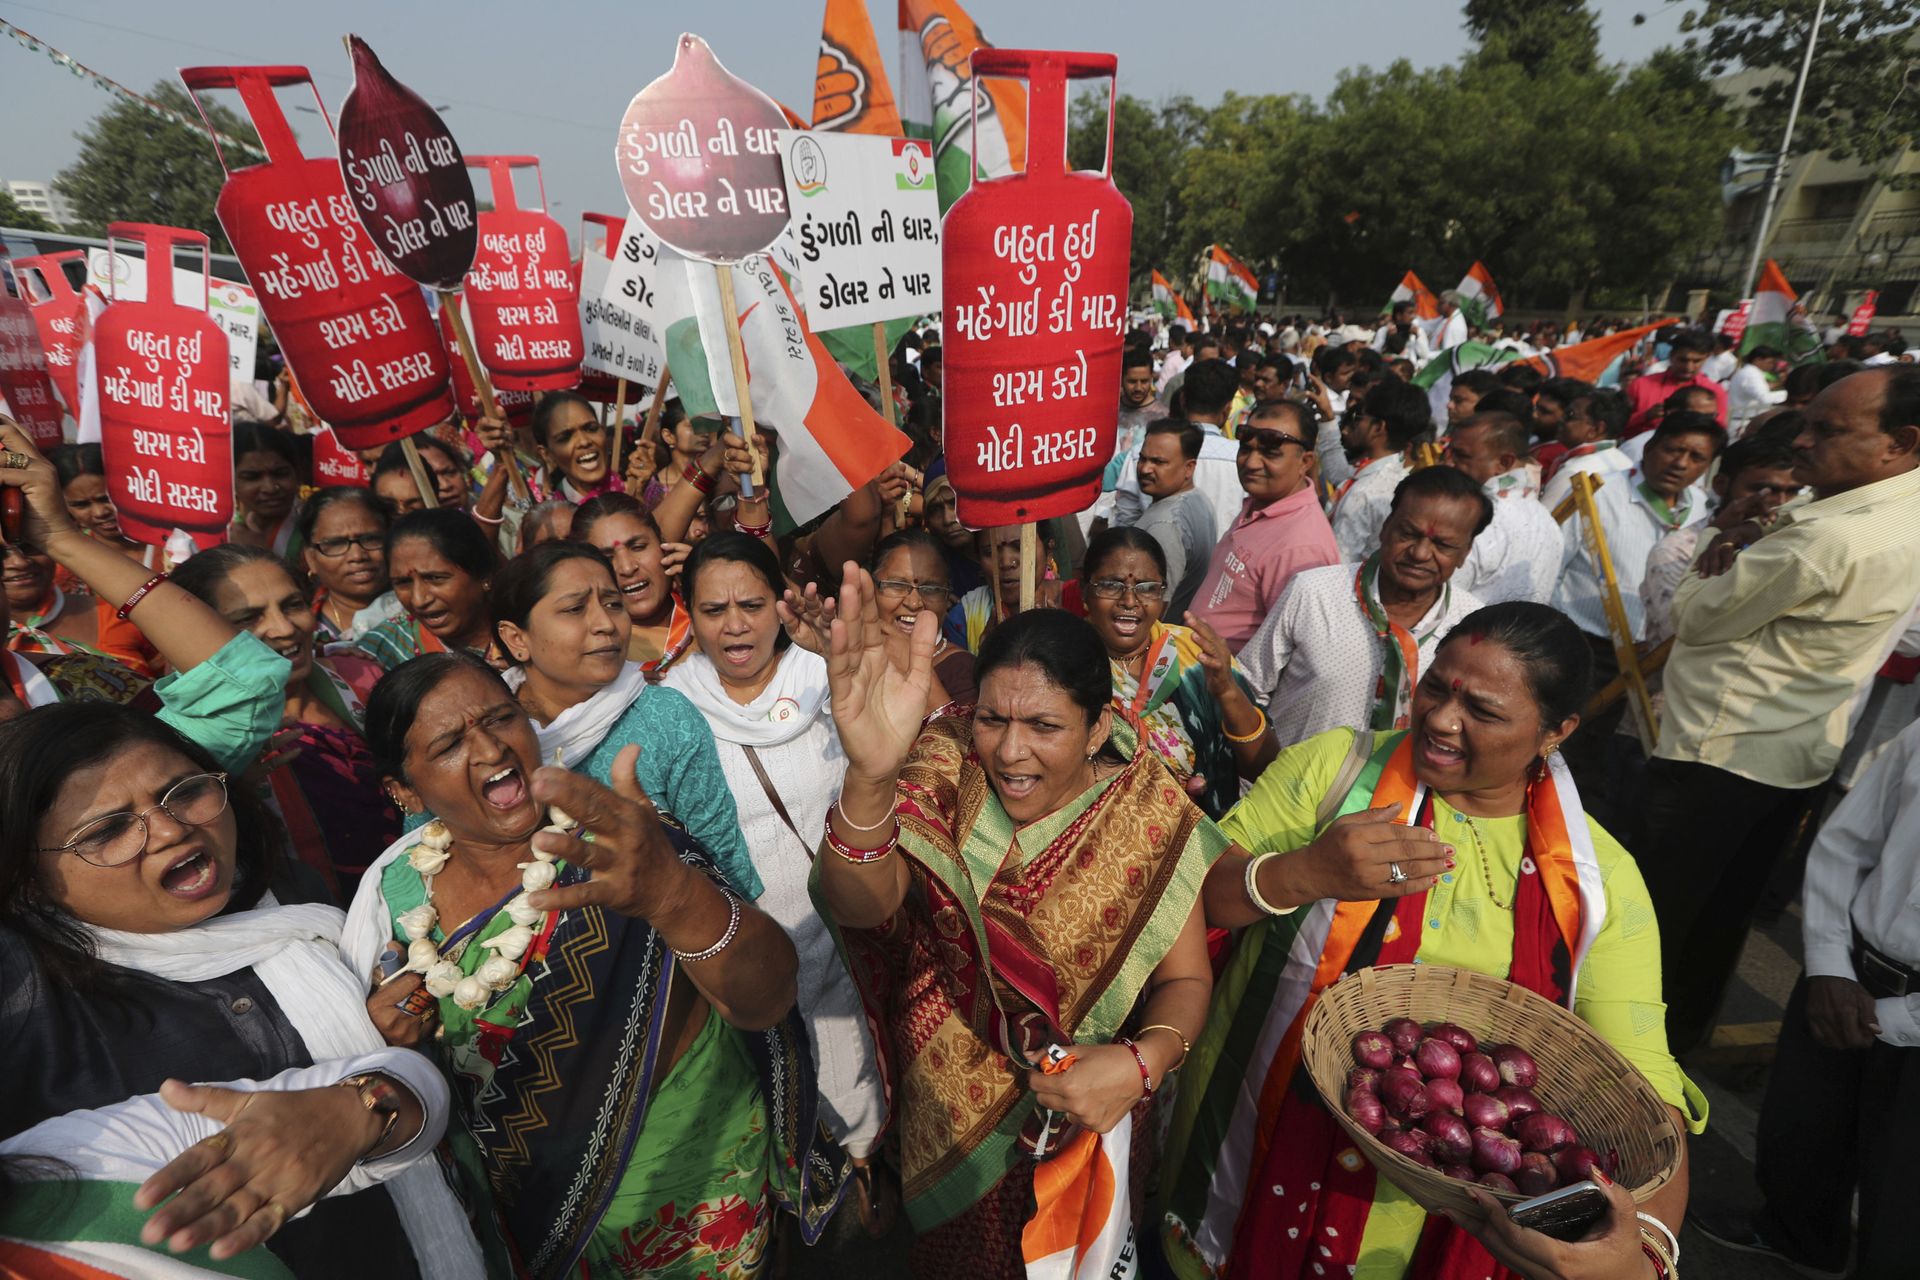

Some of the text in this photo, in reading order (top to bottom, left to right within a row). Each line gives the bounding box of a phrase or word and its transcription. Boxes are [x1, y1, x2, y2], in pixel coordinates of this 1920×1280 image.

[347, 131, 457, 211] ડુંગળી ની ધાર
[627, 119, 701, 176] ડુંગળી
[707, 118, 738, 155] ની
[265, 199, 328, 249] બહુત
[648, 178, 785, 220] ડોલર ને પાર
[384, 199, 473, 259] ડોલર ને પાર
[483, 227, 546, 264] બહુત હુઈ
[800, 209, 938, 262] ડુંગળી ની ધાર,
[994, 209, 1099, 285] બહુત હુઈ
[259, 249, 340, 300] મહેંગાઈ
[342, 242, 370, 284] કી
[468, 262, 573, 292] મહેંગાઈ કી માર,
[819, 267, 931, 310] ડોલર ને પાર
[319, 293, 407, 349] શરમ કરો
[497, 298, 559, 326] શરમ કરો
[956, 281, 1122, 341] મહેંગાઈ કી માર,
[127, 329, 202, 377] બહુત હુઈ
[494, 334, 572, 361] મોદી સરકાર
[104, 366, 228, 424] મહેંગાઈ કી માર,
[331, 352, 436, 403] મોદી સરકાર
[993, 350, 1088, 407] શરમ કરો
[132, 427, 206, 464] શરમ કરો
[977, 423, 1097, 473] મોદી સરકાર
[126, 465, 218, 513] મોદી સરકાર
